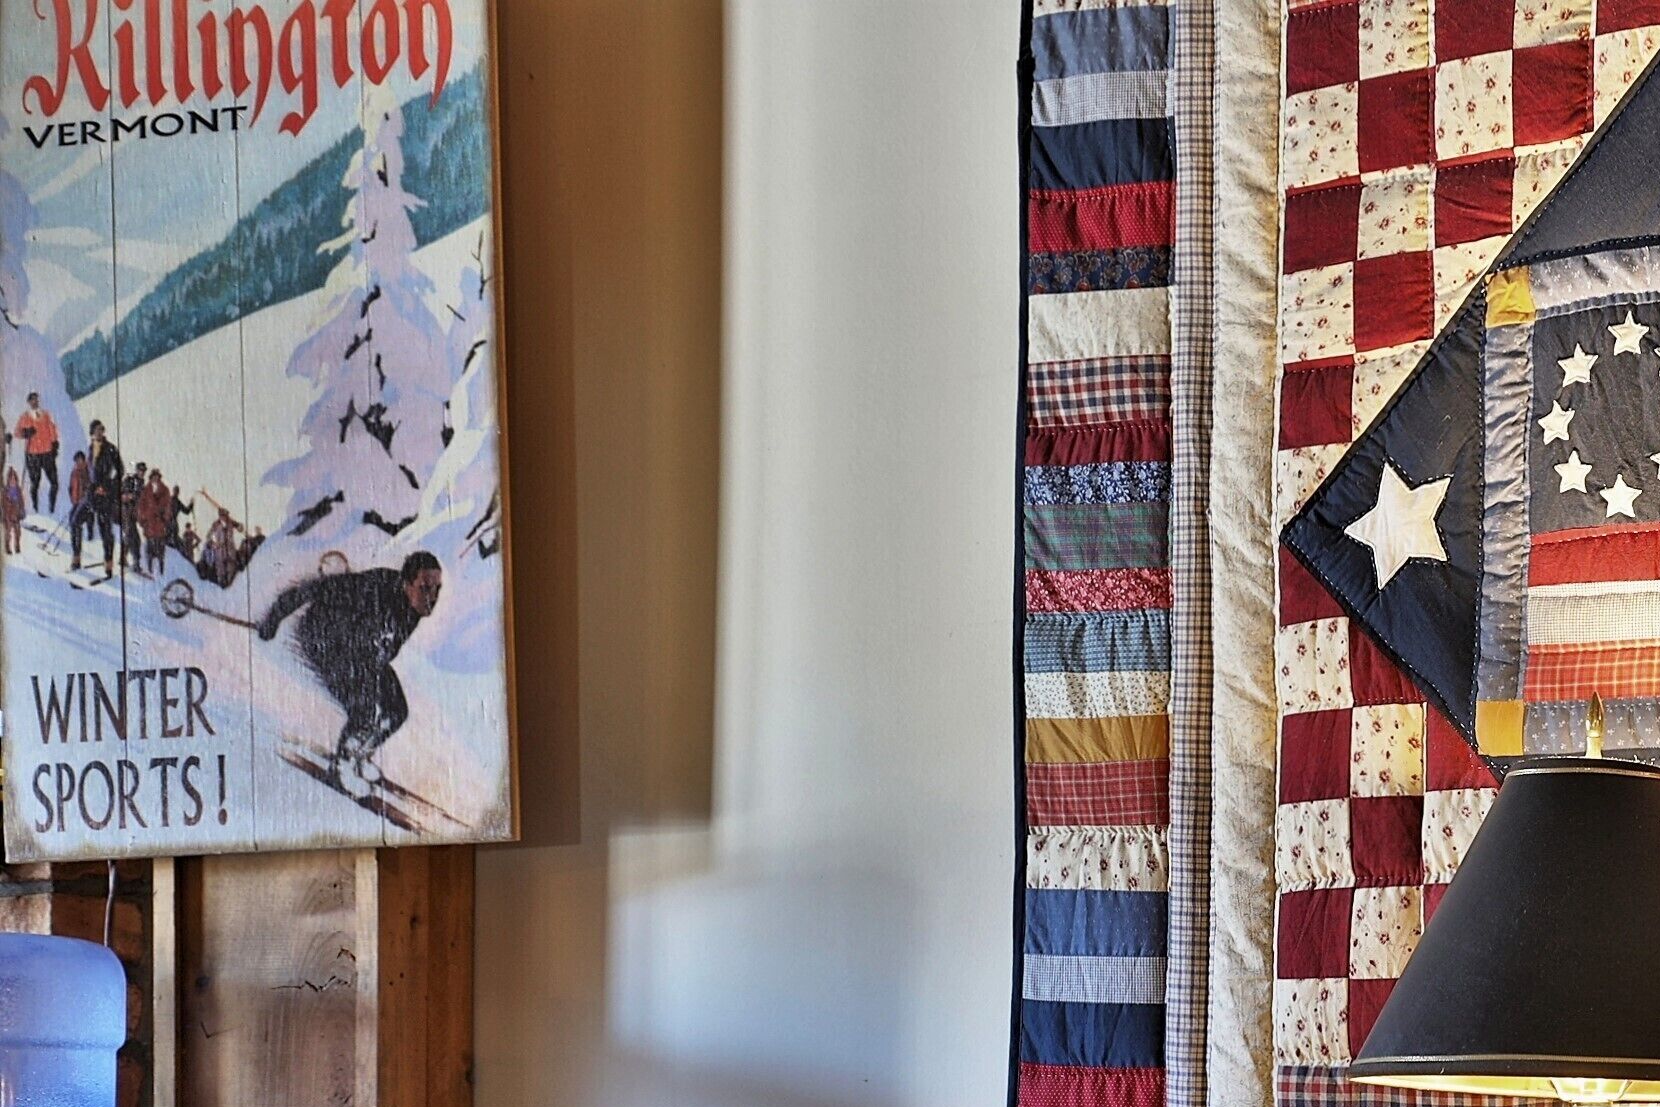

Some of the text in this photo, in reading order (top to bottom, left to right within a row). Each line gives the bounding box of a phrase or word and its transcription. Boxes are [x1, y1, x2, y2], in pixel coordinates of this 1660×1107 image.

[22, 106, 248, 149] VERMONT
[30, 667, 216, 743] WINTER
[32, 755, 228, 833] SPORTS!
